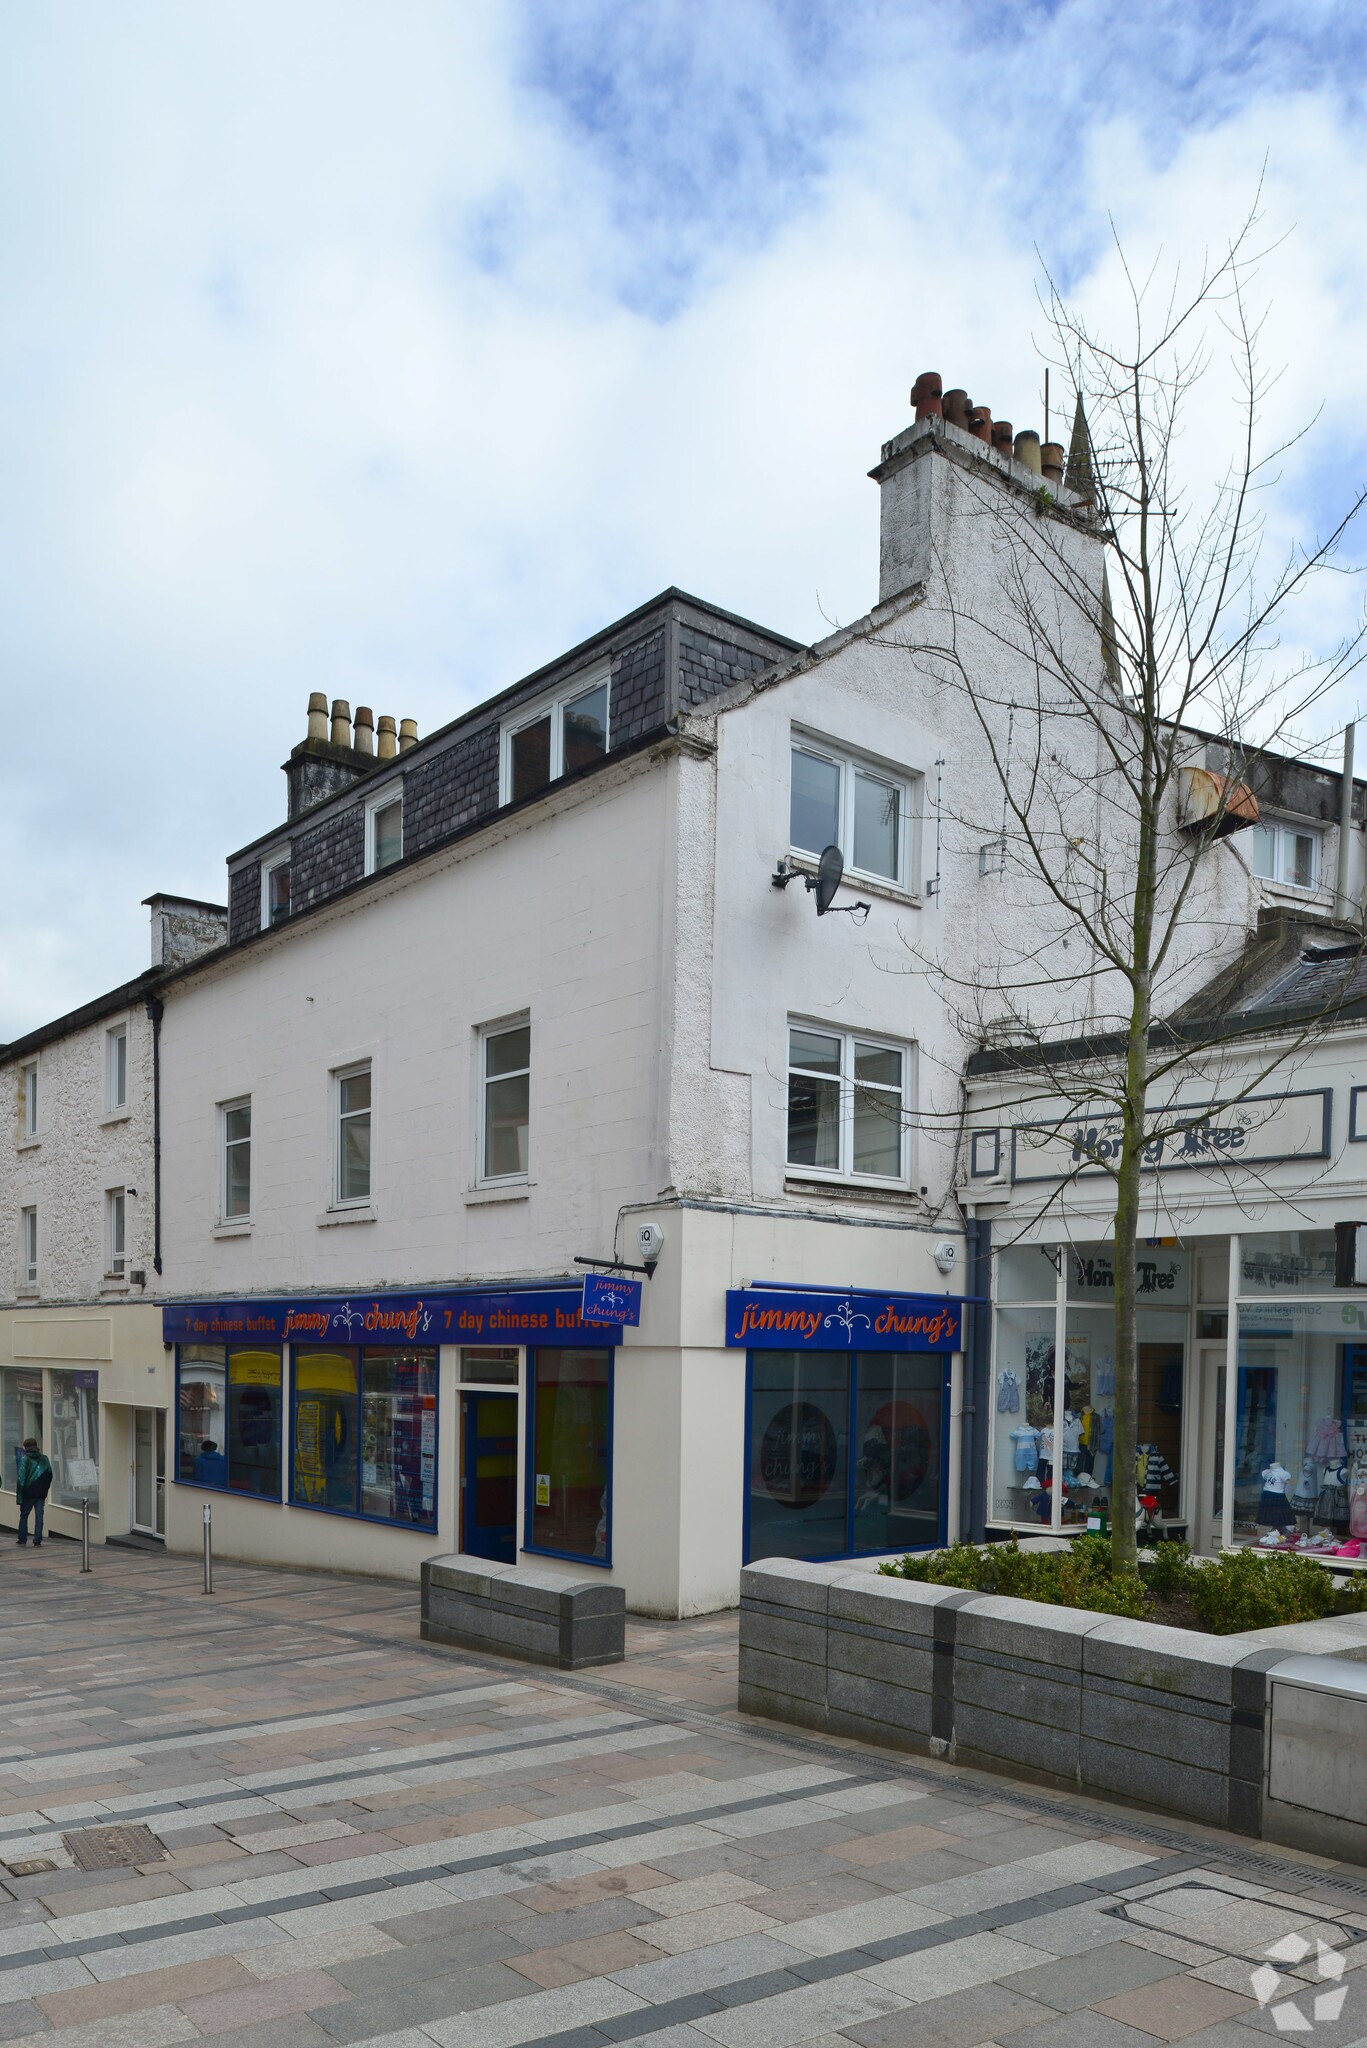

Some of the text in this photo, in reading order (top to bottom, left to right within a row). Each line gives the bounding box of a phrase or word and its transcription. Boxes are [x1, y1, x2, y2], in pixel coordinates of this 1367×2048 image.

[1072, 1117, 1244, 1163] Hony Tree
[1098, 1259, 1112, 1269] The
[593, 1279, 635, 1296] jimmy
[1136, 1262, 1175, 1293] Tree
[282, 1301, 433, 1339] jimmy chung's
[443, 1310, 453, 1329] 7
[459, 1310, 483, 1334] day
[489, 1309, 548, 1329] chinese
[586, 1304, 635, 1321] chung's
[735, 1303, 958, 1344] jimmy chung's
[185, 1315, 276, 1335] 7 day chinese buffet
[771, 1429, 825, 1451] jimmy
